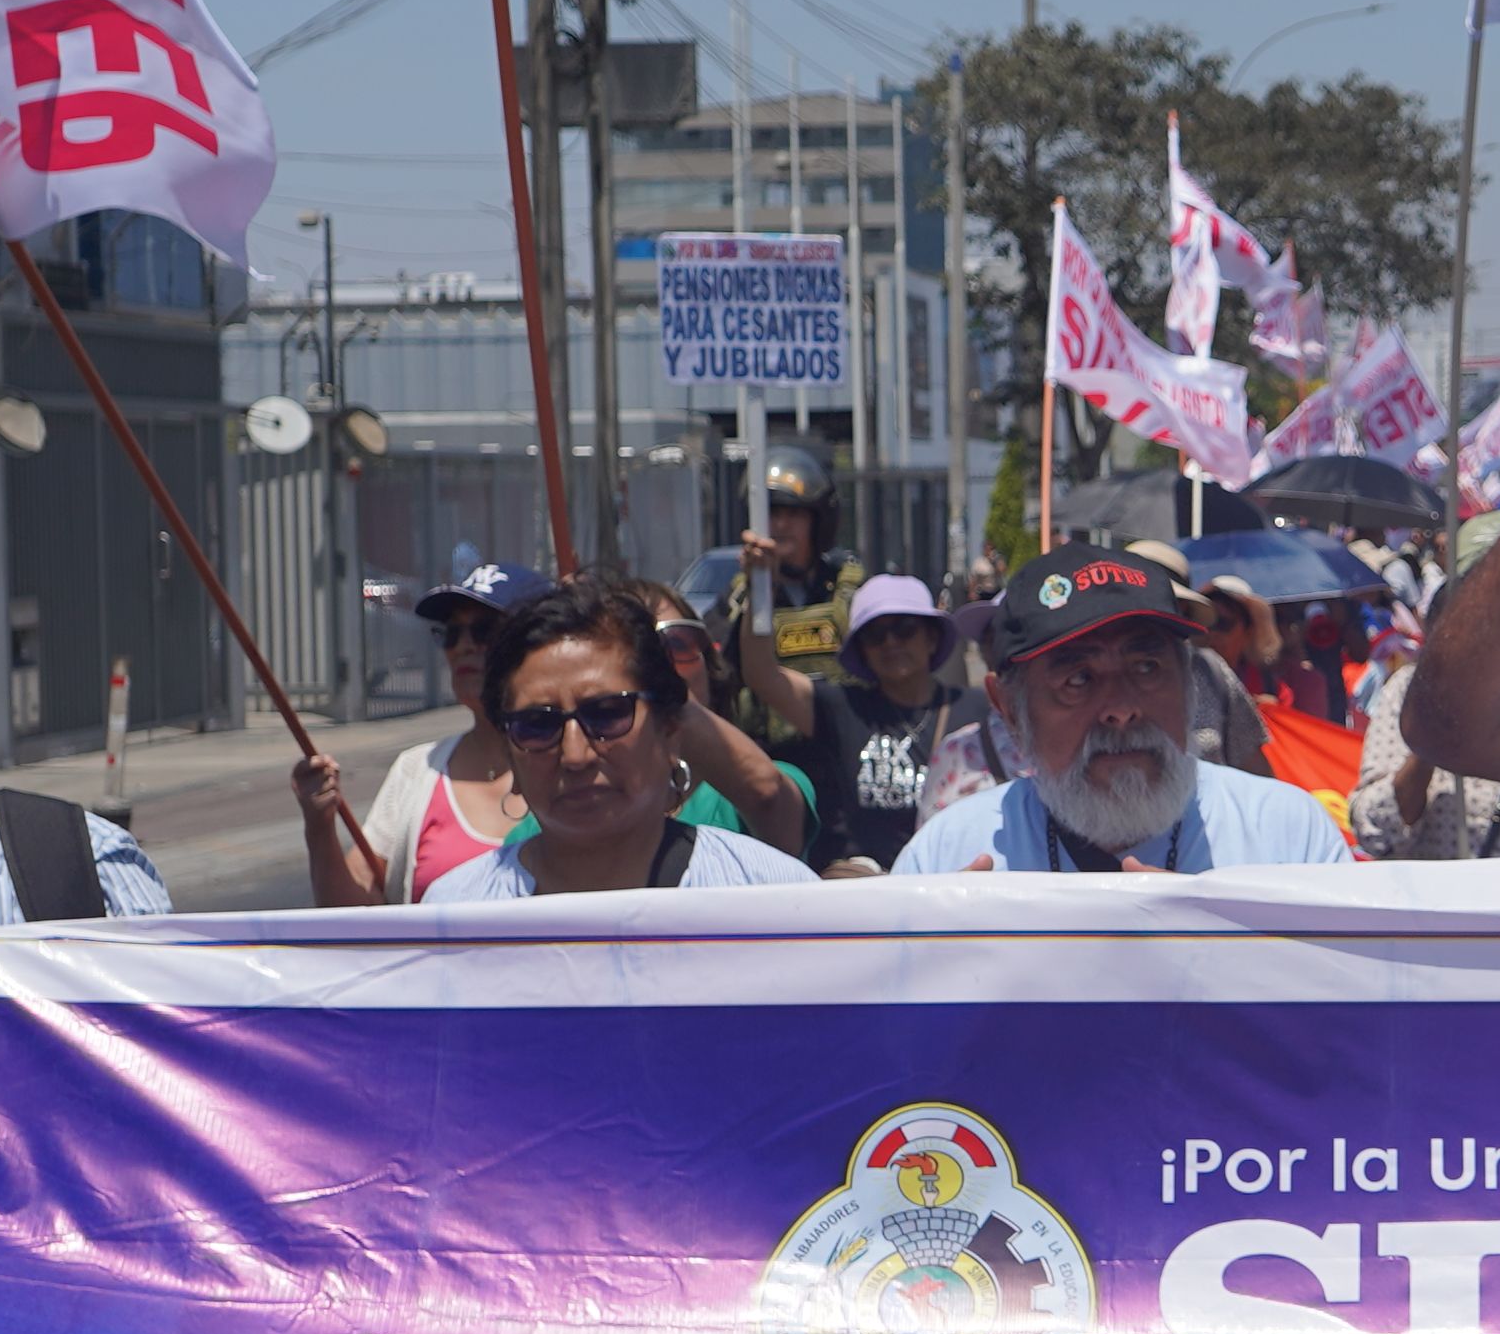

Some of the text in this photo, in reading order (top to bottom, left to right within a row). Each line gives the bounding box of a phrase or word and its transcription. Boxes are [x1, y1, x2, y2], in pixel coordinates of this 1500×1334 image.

[661, 266, 841, 303] PENSIONES DIGNAS
[662, 306, 840, 343] PARA CESANTES
[664, 345, 841, 381] Y JUBILADOS
[1159, 1138, 1306, 1204] ¡Por
[1331, 1137, 1399, 1193] la
